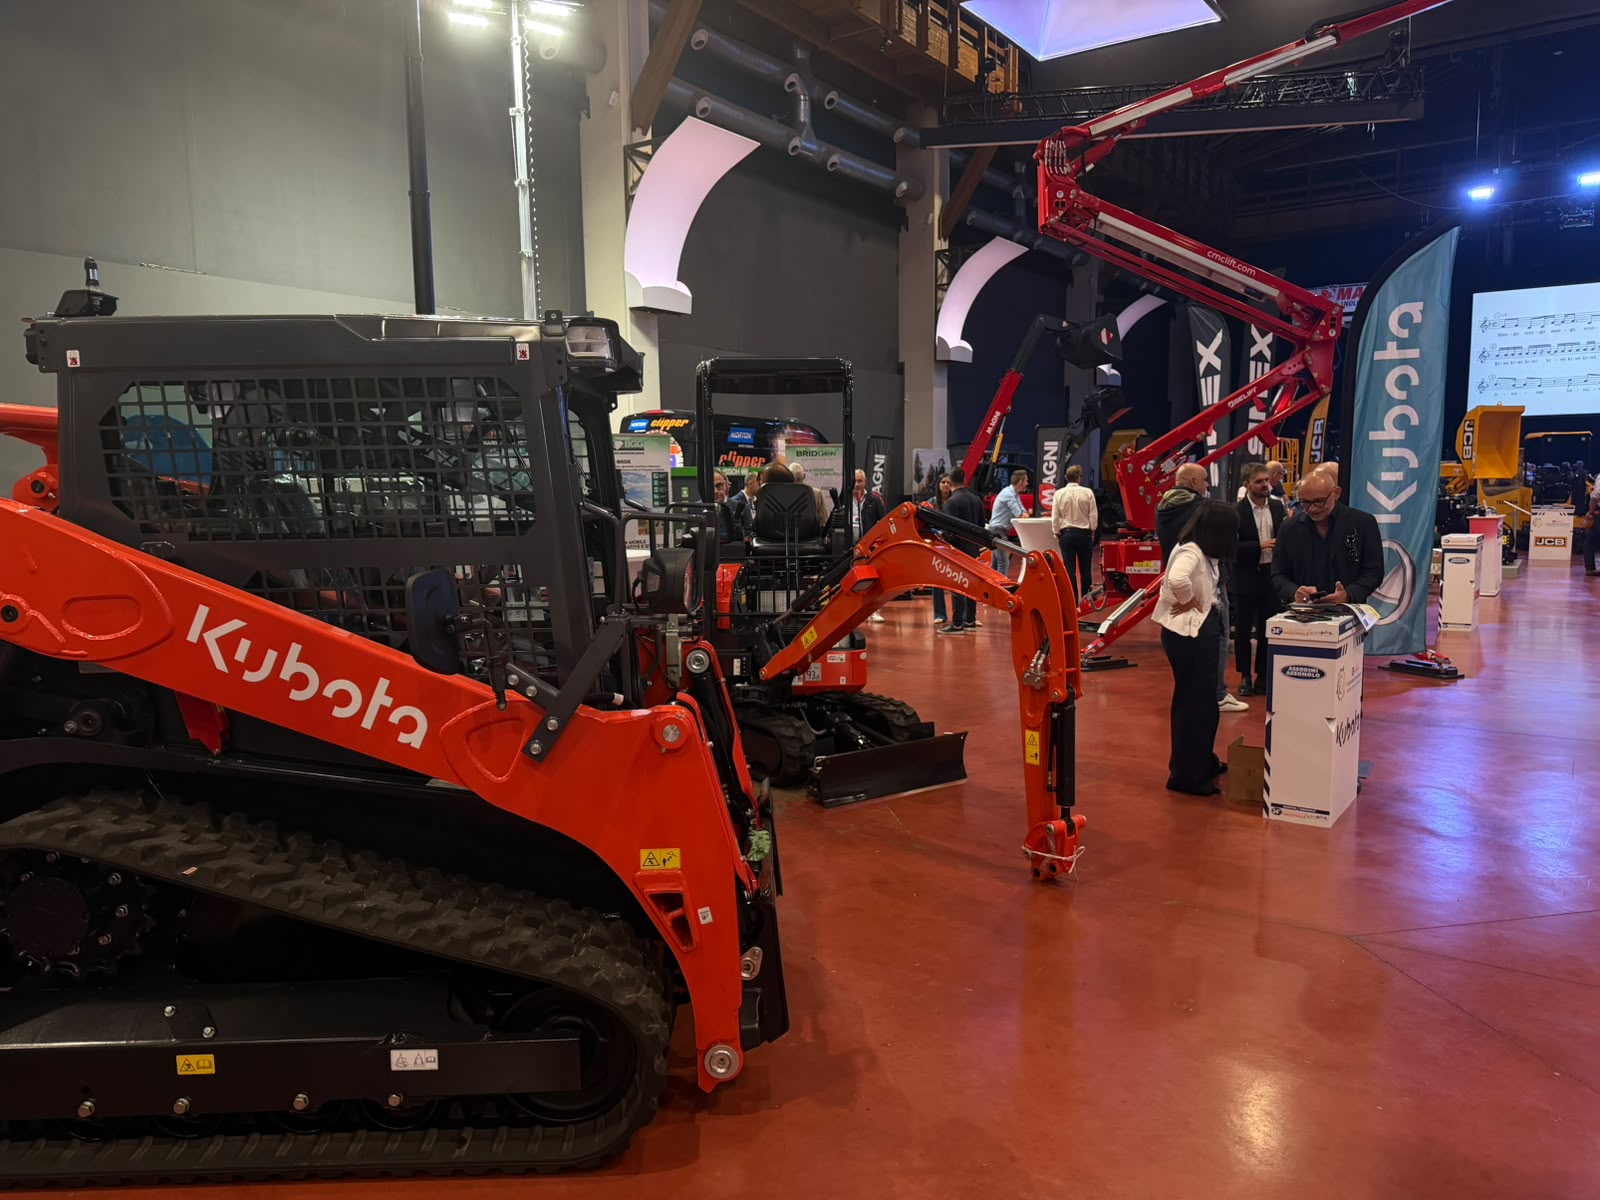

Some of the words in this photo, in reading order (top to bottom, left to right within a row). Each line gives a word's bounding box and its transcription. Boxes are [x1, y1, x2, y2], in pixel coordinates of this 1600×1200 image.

[1206, 250, 1257, 277] cmclift.com
[650, 417, 690, 431] clipper
[985, 410, 1001, 435] MAGNI
[1366, 301, 1424, 524] Kubota
[1310, 419, 1325, 463] JCB
[1462, 420, 1474, 459] JCB
[719, 450, 766, 468] clipper
[871, 454, 886, 494] AGNI
[1041, 441, 1059, 506] MAGNI
[1536, 538, 1566, 546] JCB
[931, 556, 970, 589] Kubota
[186, 603, 428, 750] Kubota
